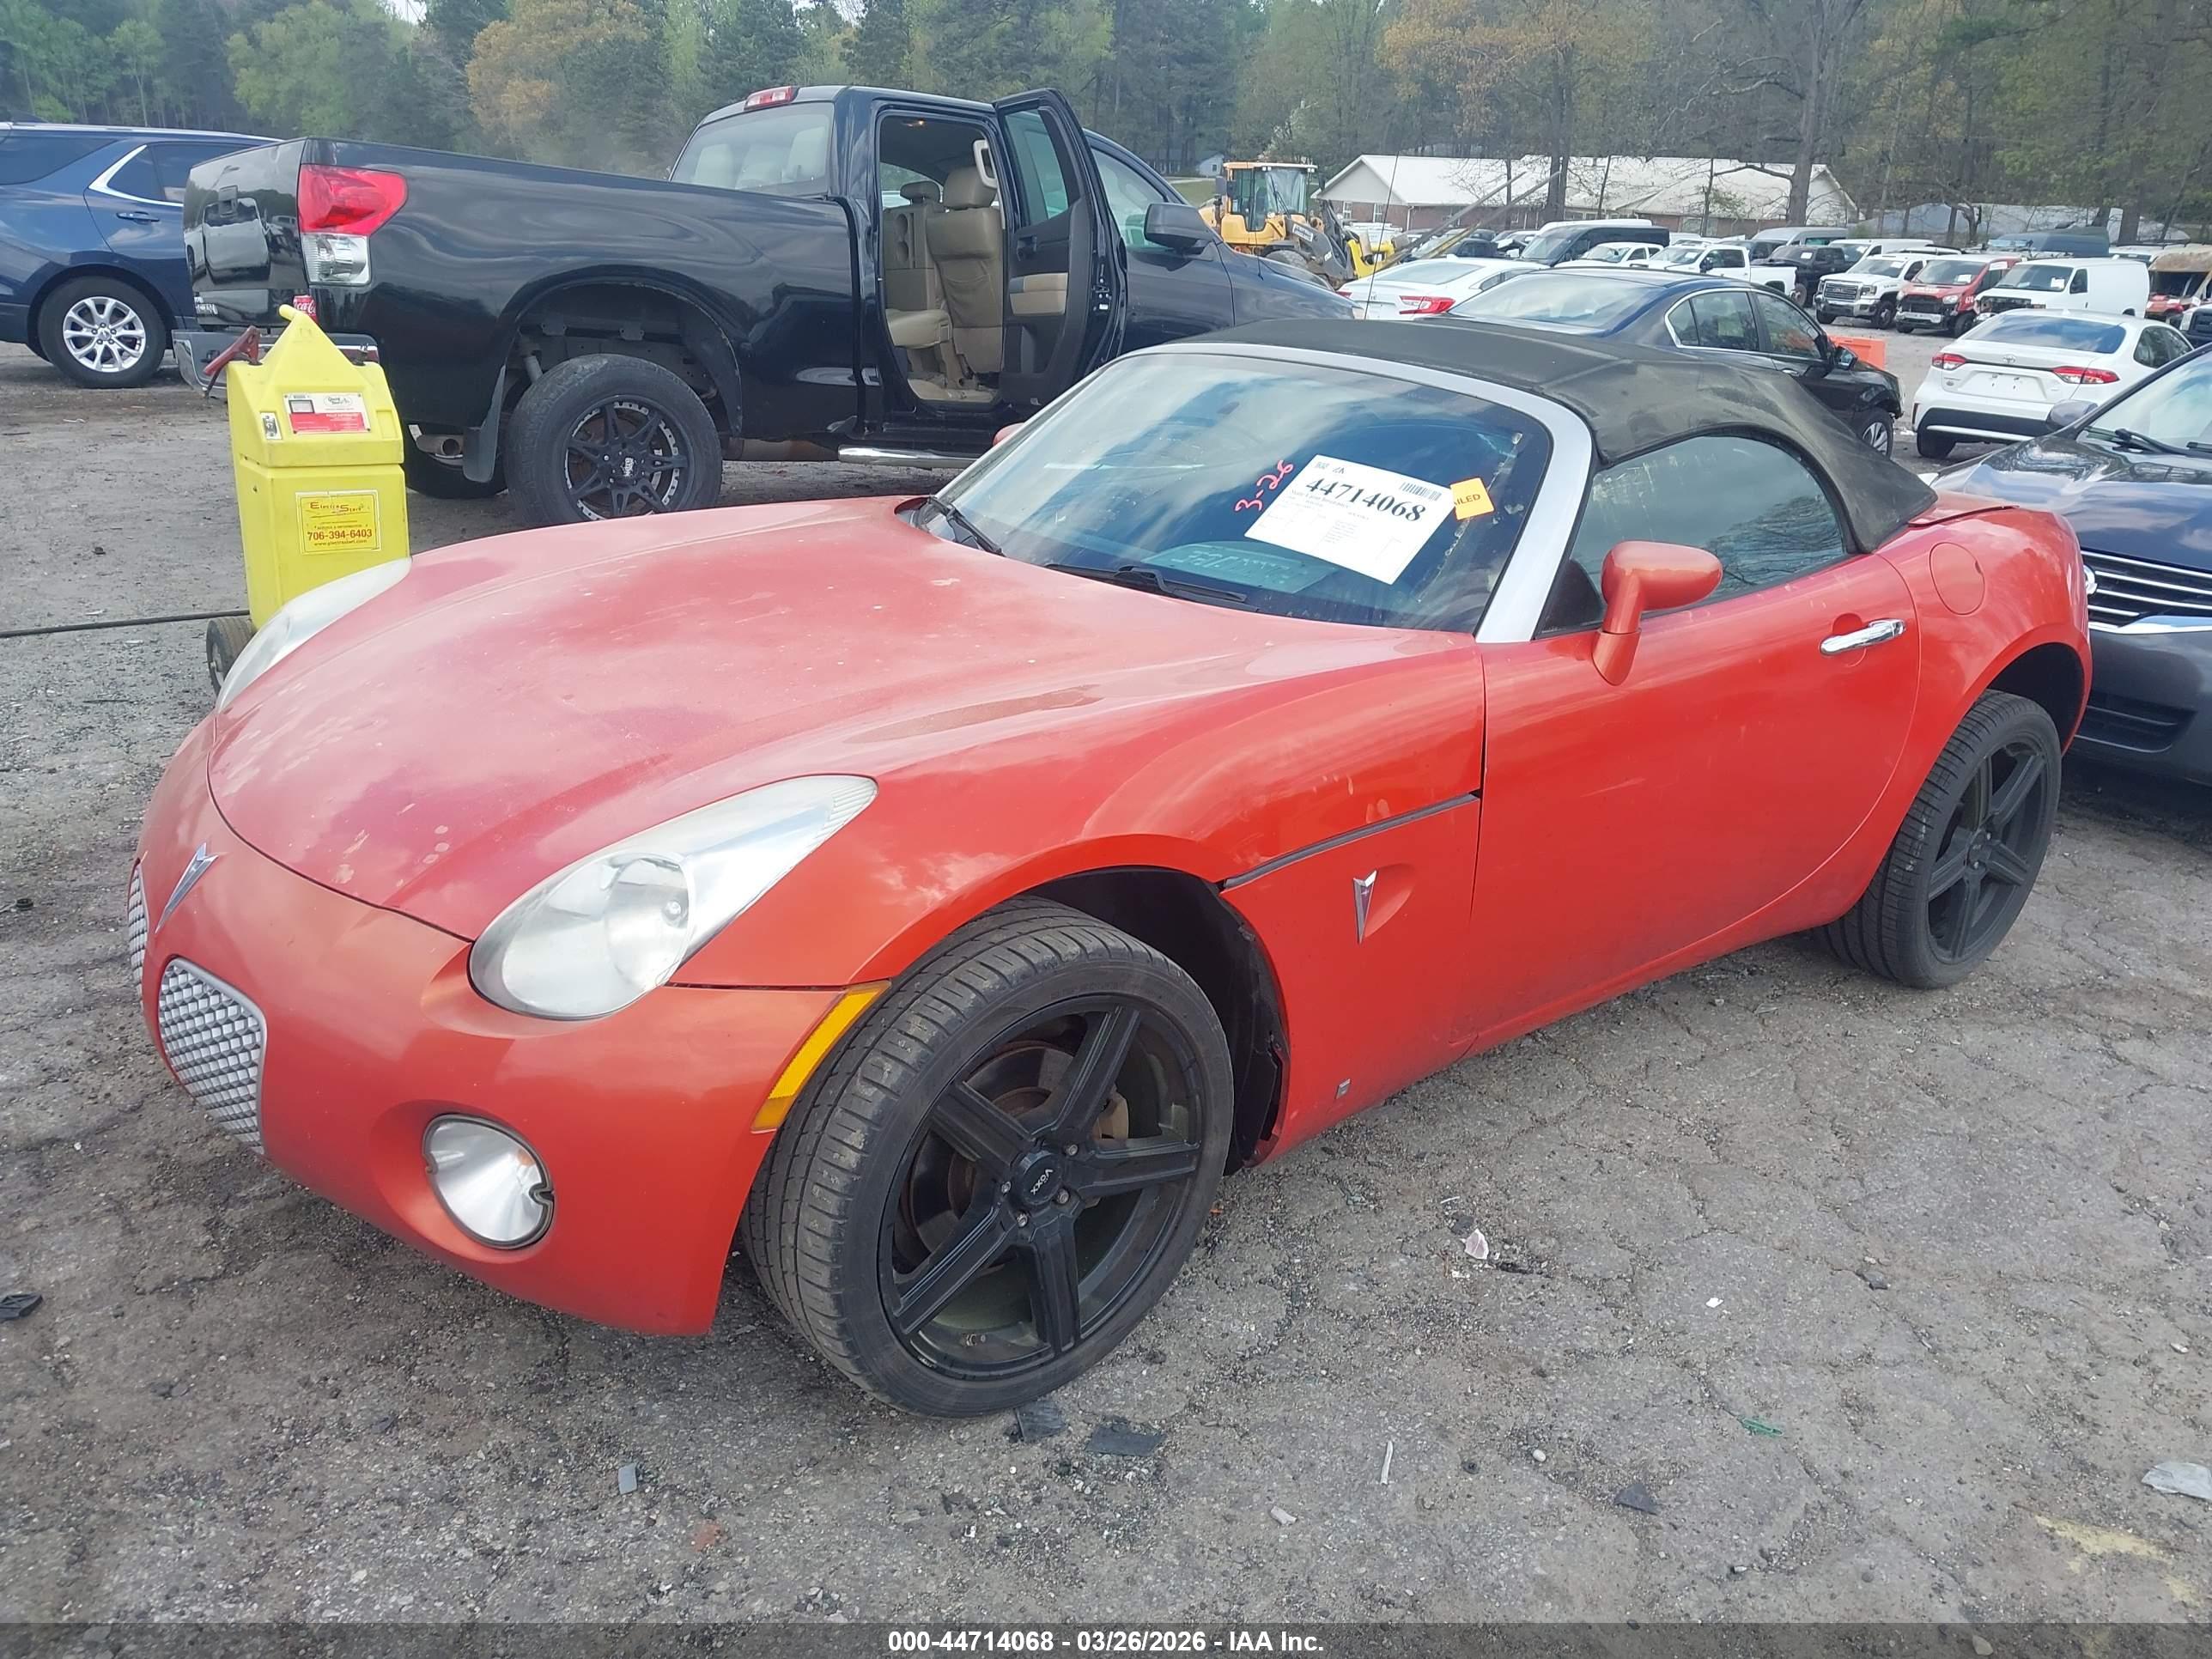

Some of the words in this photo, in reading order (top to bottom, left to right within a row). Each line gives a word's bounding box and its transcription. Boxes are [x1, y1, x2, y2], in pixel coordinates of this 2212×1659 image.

[1305, 477, 1426, 522] 44714068
[307, 529, 373, 541] 706-394-6403
[1030, 1169, 1054, 1195] VOXX
